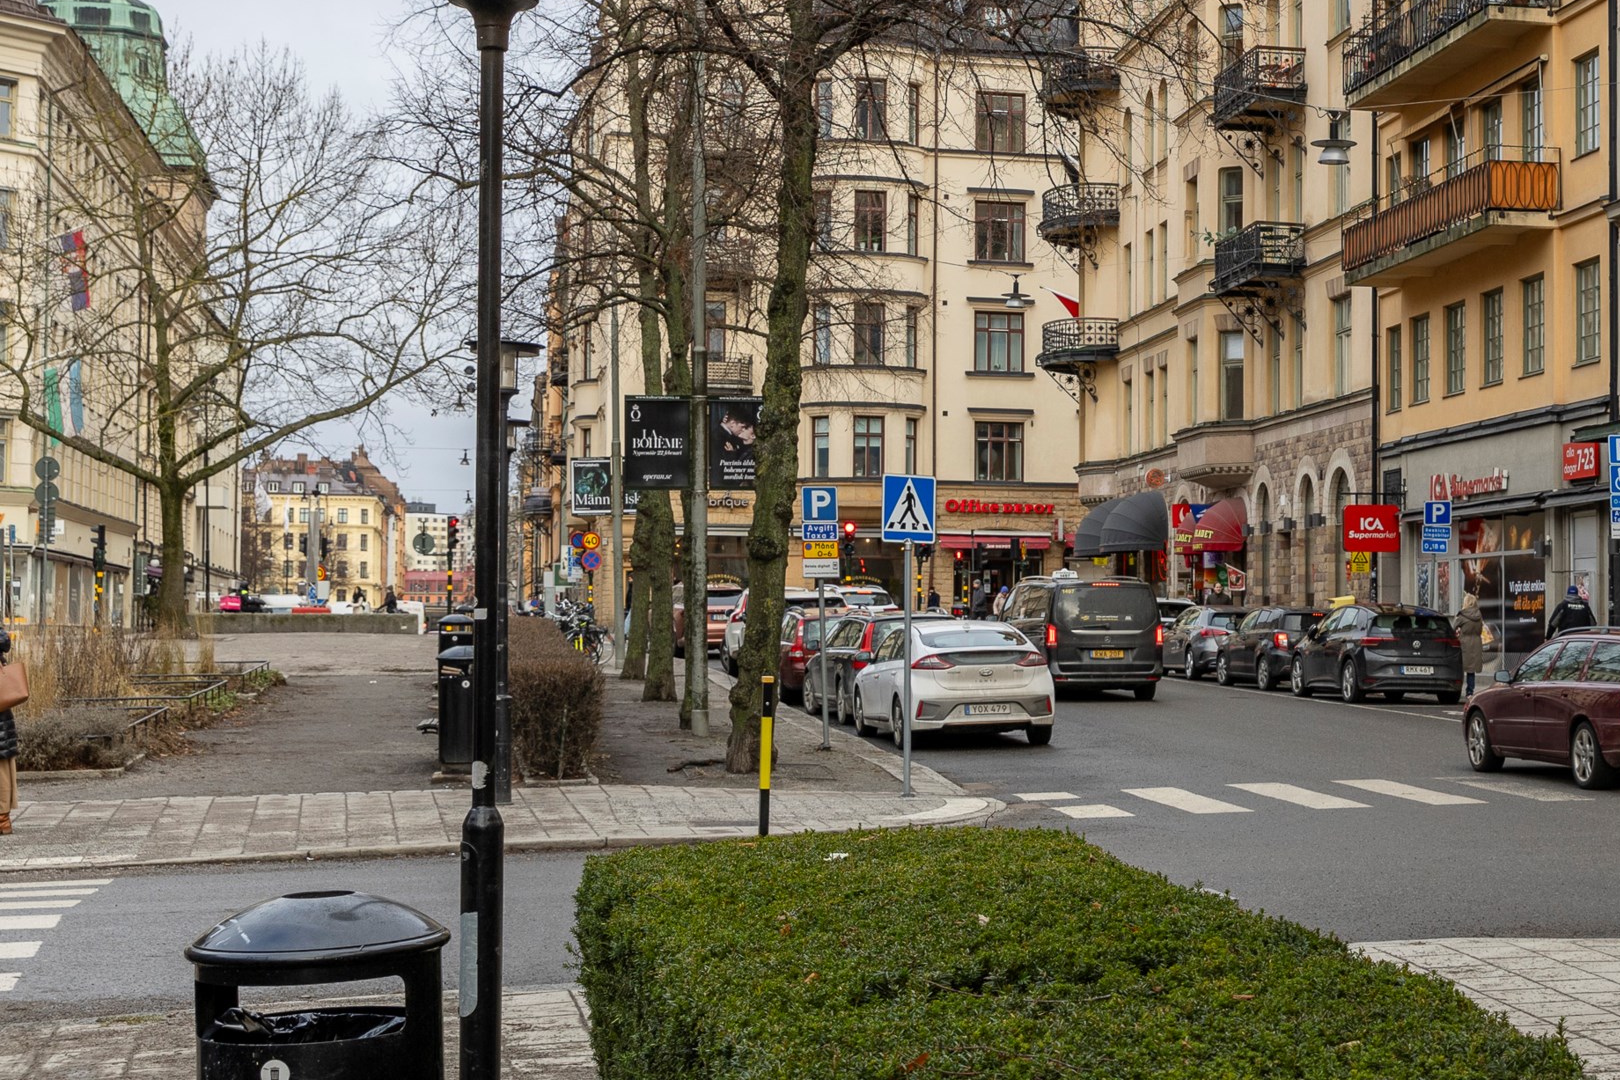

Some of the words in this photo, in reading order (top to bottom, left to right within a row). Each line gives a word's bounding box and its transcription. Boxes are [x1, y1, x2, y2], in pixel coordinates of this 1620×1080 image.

[632, 436, 683, 449] BOHÈME
[1566, 447, 1575, 458] alla
[1576, 447, 1595, 471] 7-23
[1564, 464, 1577, 475] dagar
[642, 472, 672, 480] operan.se
[1429, 473, 1451, 500] ICA
[1450, 467, 1509, 501] Supermarket
[811, 490, 831, 519] P
[945, 499, 999, 513] Office
[1002, 503, 1055, 514] DEPOT
[1432, 504, 1446, 523] P
[807, 525, 834, 533] Avgift
[1360, 517, 1384, 531] ICA
[585, 536, 598, 545] 40
[1348, 529, 1396, 540] Supermarket
[972, 705, 989, 713] YOX
[991, 705, 1008, 713] 479
